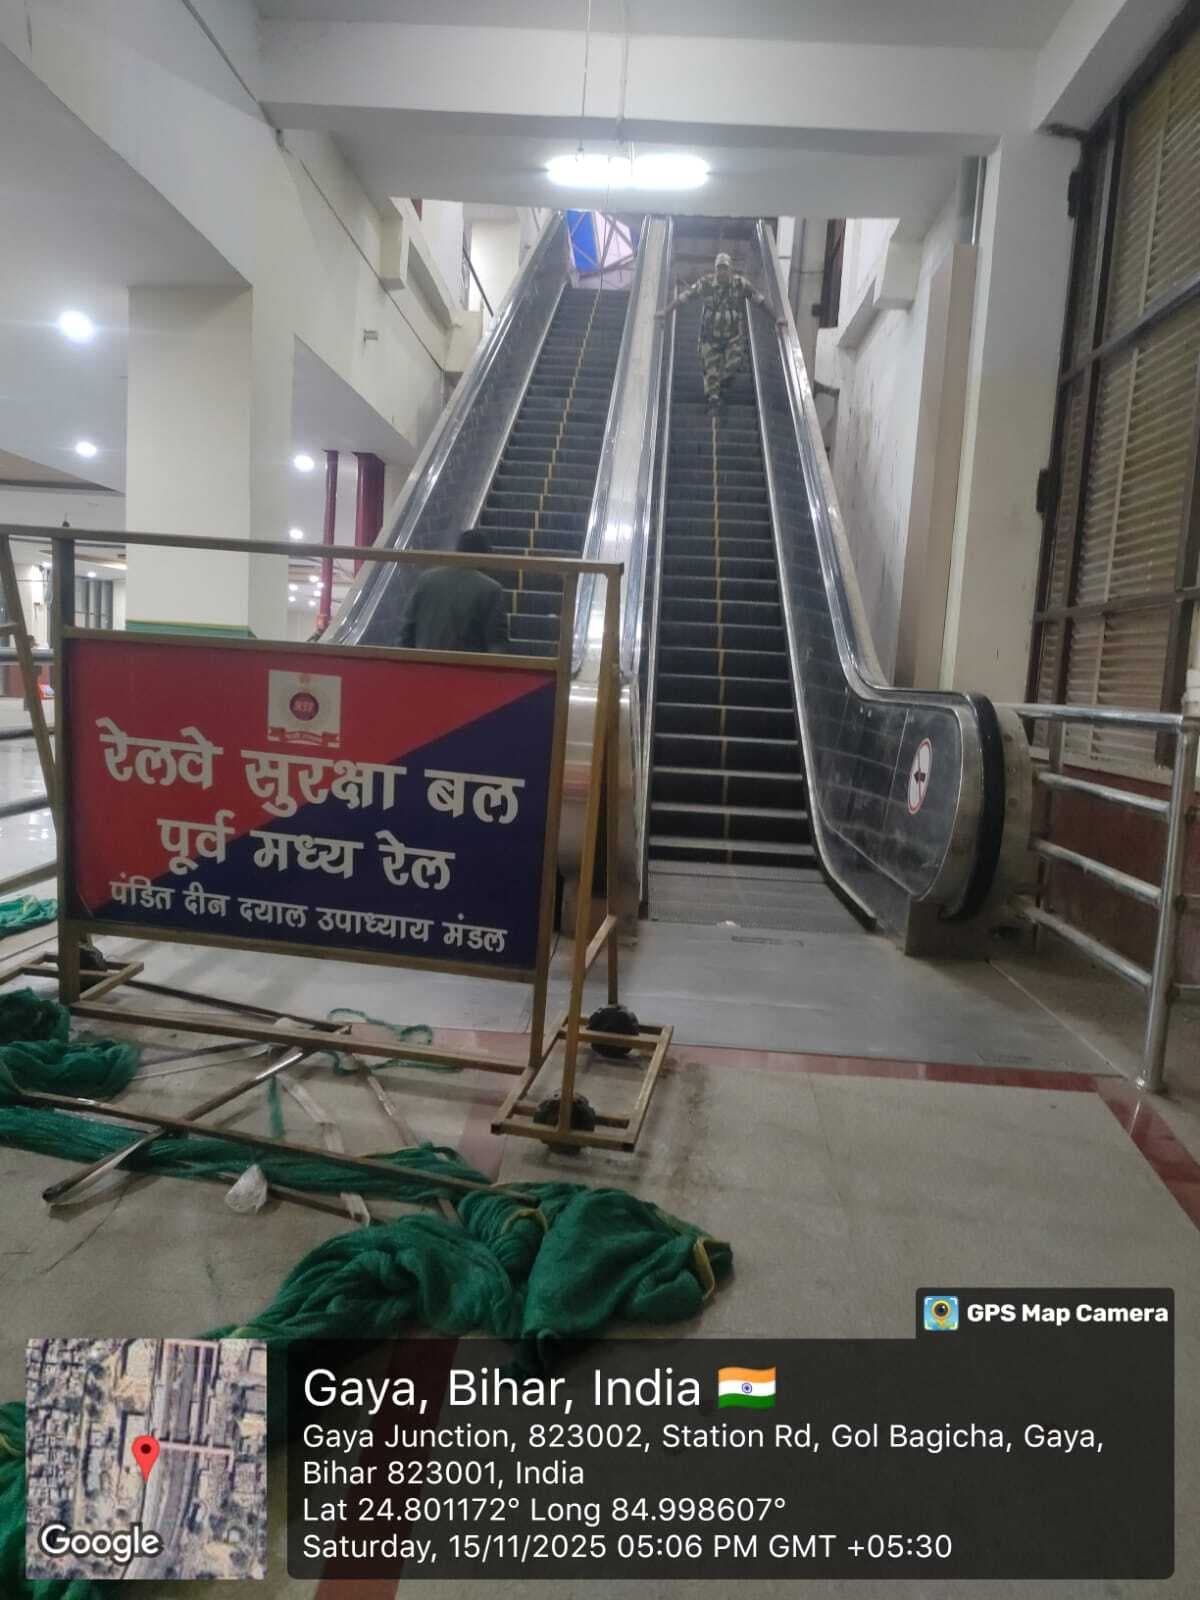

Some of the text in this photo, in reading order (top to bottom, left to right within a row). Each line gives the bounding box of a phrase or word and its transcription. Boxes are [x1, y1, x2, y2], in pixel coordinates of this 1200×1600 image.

[96, 717, 526, 824] रेलवे सुरक्षा बल
[156, 810, 455, 890] पूर्व मध्य रेल
[109, 872, 507, 953] पंडित दीन दयाल उपाध्याय मंडल
